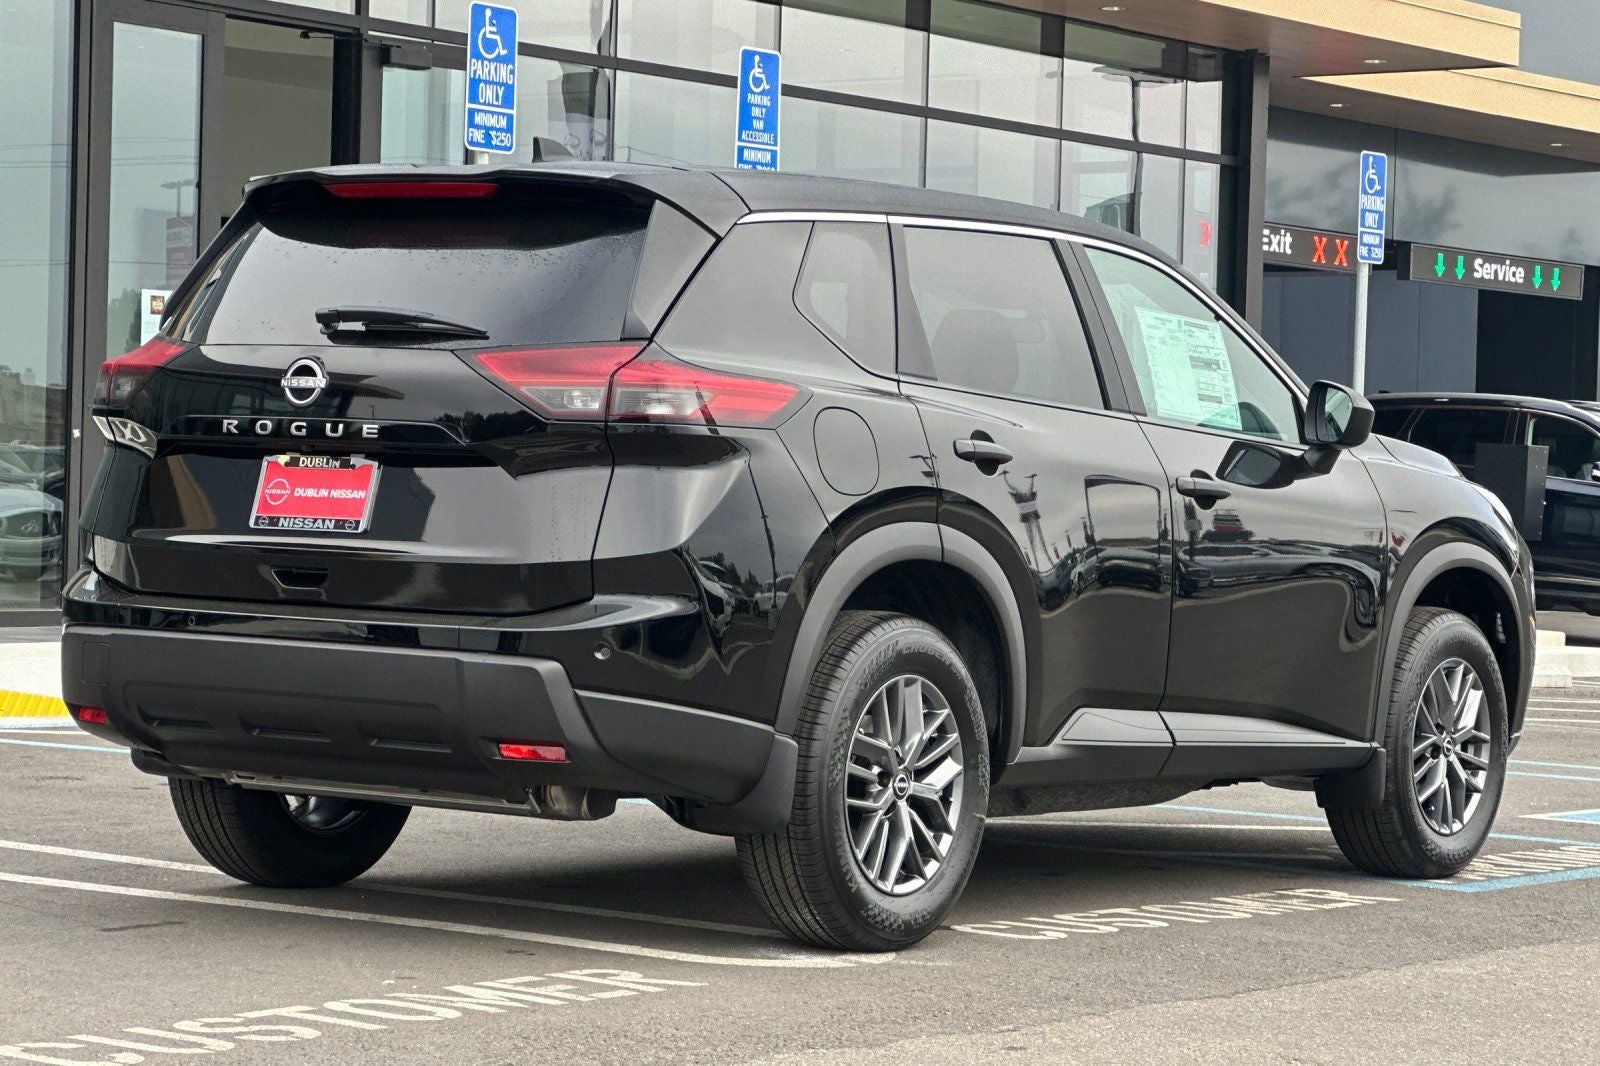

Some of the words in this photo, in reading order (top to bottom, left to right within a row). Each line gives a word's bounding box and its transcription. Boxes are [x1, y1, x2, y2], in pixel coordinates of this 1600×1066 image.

[470, 58, 513, 85] PARKING
[479, 83, 505, 105] ONLY
[747, 93, 770, 107] PARKING
[474, 112, 507, 129] MINIMUM
[751, 106, 766, 118] ONLY
[753, 119, 764, 130] VAN
[468, 128, 486, 143] FINE
[490, 131, 511, 147] $250
[741, 130, 775, 144] ACCESSIBLE
[743, 149, 771, 164] MINIMUM
[1361, 193, 1384, 212] PARKING
[1365, 211, 1379, 228] ONLY
[1262, 229, 1292, 254] Exit
[1473, 258, 1525, 283] Service
[281, 378, 325, 388] NISSAN
[222, 419, 379, 438] ROGUE
[299, 457, 341, 468] DUBLIN
[294, 487, 329, 498] DUBLIN
[330, 488, 366, 499] NISSAN
[278, 517, 335, 529] NISSAN
[949, 888, 1403, 940] CUSTOMER
[0, 968, 708, 1066] CUSTOMER
